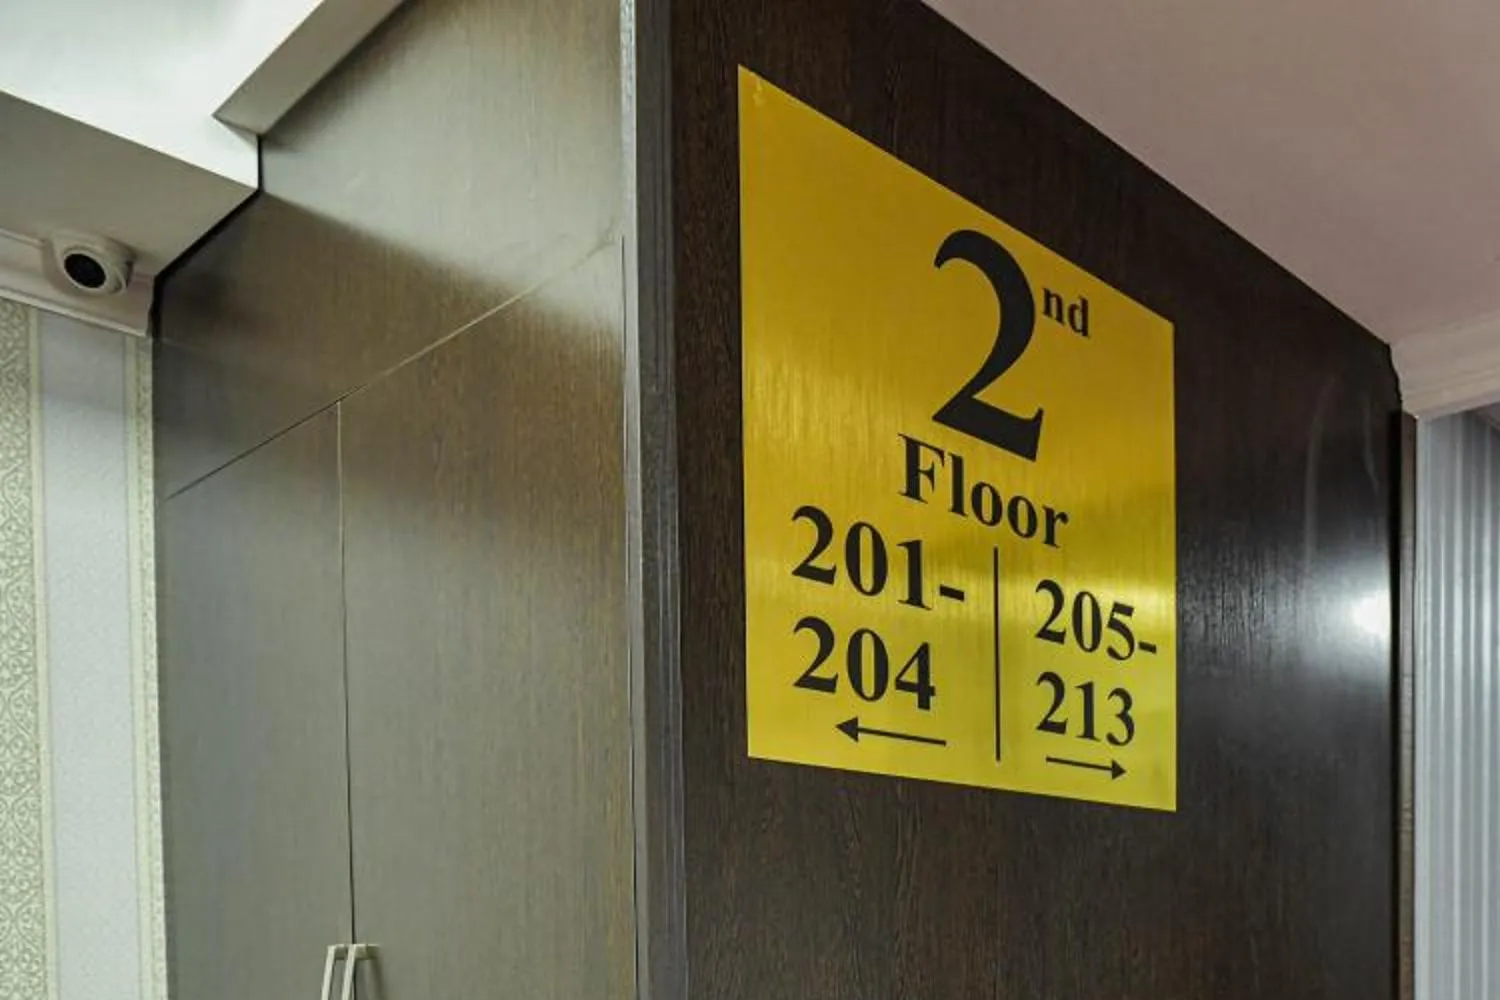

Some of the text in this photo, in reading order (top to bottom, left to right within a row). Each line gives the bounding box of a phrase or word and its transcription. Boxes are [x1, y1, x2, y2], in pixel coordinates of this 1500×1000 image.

[931, 228, 1090, 462] 2nd
[898, 433, 1069, 549] Floor
[791, 505, 966, 610] 201-
[793, 616, 937, 712] 204
[1035, 579, 1157, 662] 205-
[1035, 671, 1135, 747] 213
